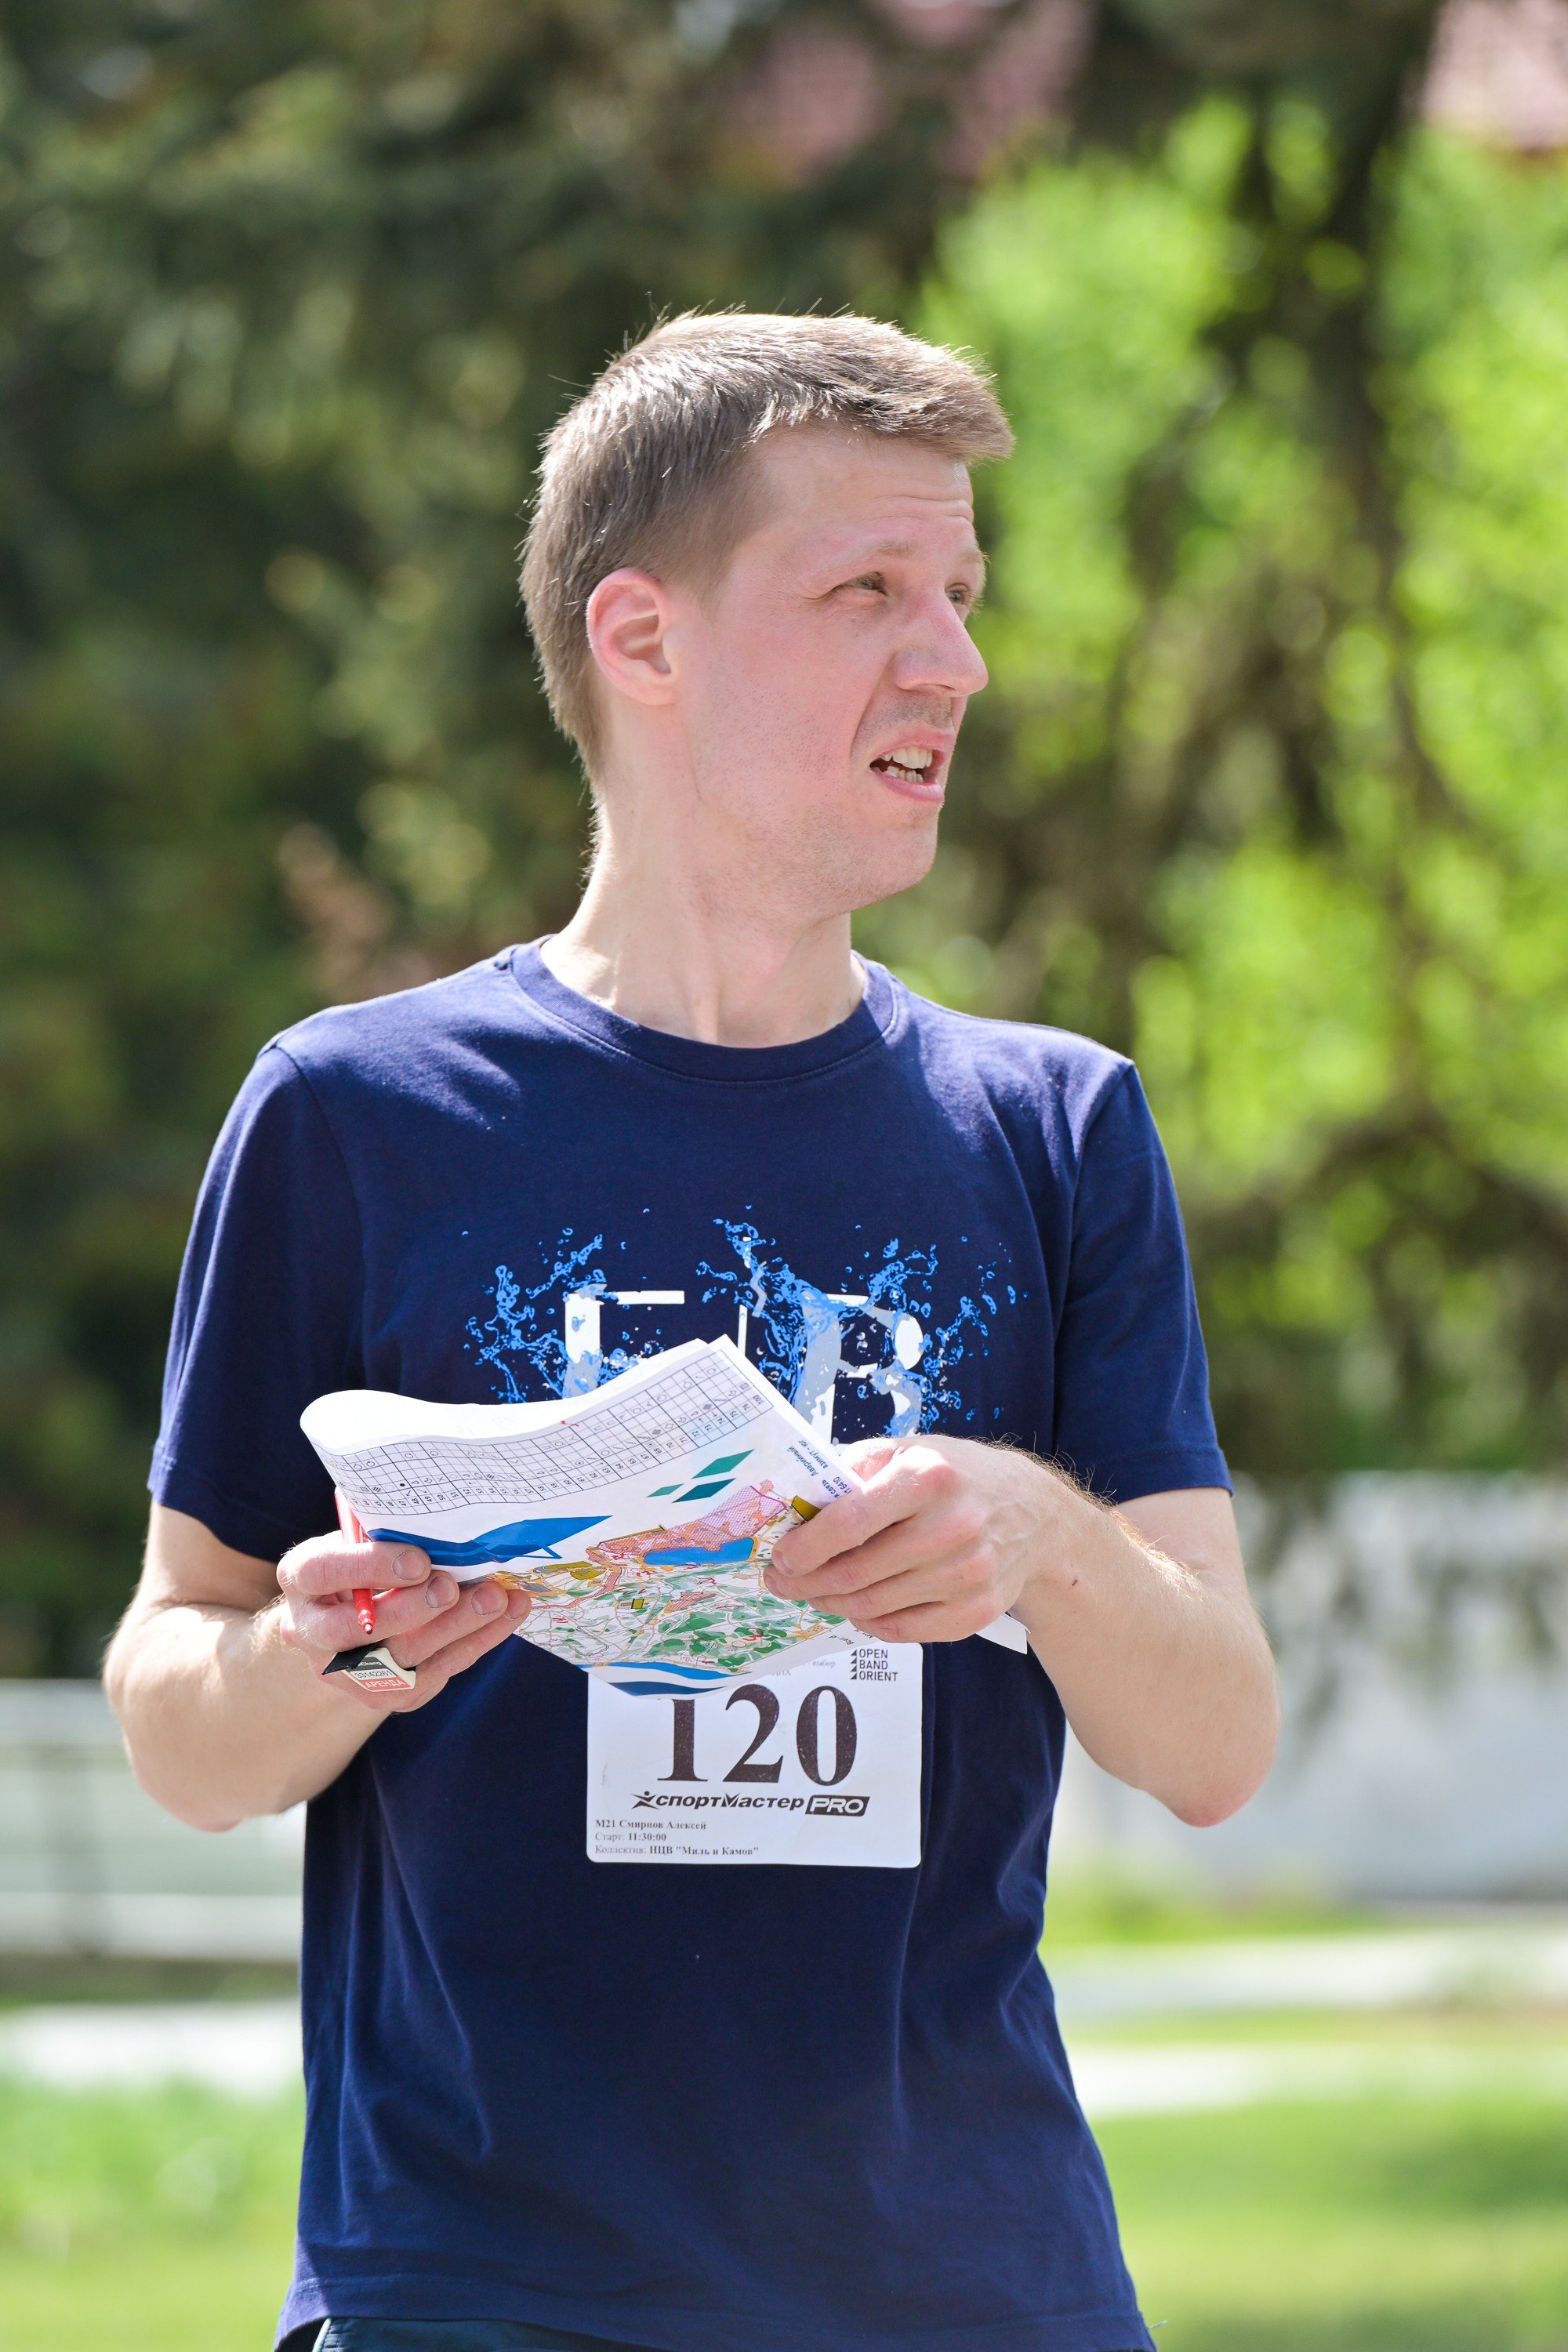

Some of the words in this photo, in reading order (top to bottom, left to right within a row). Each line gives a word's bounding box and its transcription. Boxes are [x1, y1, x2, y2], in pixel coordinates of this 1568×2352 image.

[753, 1395, 764, 1405] 100
[798, 1439, 808, 1448] юг
[786, 1445, 819, 1476] Аварийный
[808, 1449, 829, 1469] азимут
[822, 1479, 837, 1494] связь
[858, 1649, 888, 1660] OPEN
[858, 1660, 888, 1670] BAND
[858, 1670, 898, 1682] ORIENT
[365, 1679, 406, 1688] АРЕНДА
[657, 1683, 858, 1786] 120
[808, 1797, 866, 1815] PRO
[595, 1820, 616, 1828] М21
[619, 1820, 664, 1830] Смирнов
[666, 1820, 707, 1830] Алексей
[595, 1832, 625, 1842] Старт:
[628, 1833, 667, 1842] 11:30:00
[595, 1846, 647, 1854] Коллектив:
[649, 1846, 673, 1856] НЦВ
[676, 1846, 710, 1855] "Миль
[721, 1846, 760, 1856] Камов"
